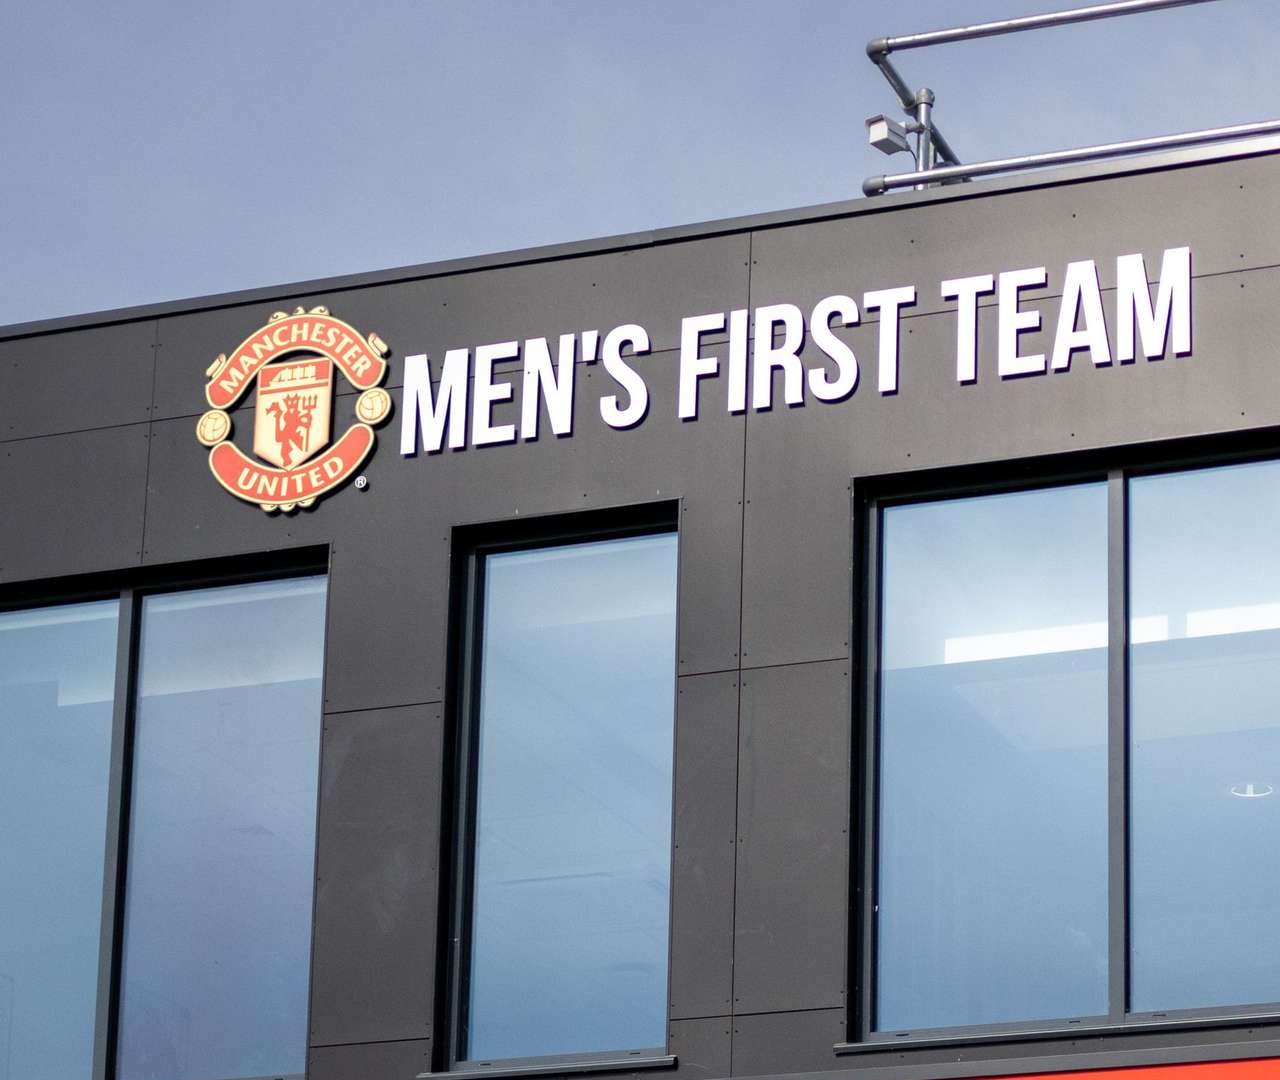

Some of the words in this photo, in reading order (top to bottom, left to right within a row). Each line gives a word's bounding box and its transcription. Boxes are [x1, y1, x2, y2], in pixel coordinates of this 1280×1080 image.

[220, 321, 372, 394] MANCHESTER
[400, 324, 649, 455] MEN'S
[678, 286, 915, 419] FIRST
[941, 246, 1191, 382] TEAM
[238, 456, 344, 497] UNITED
